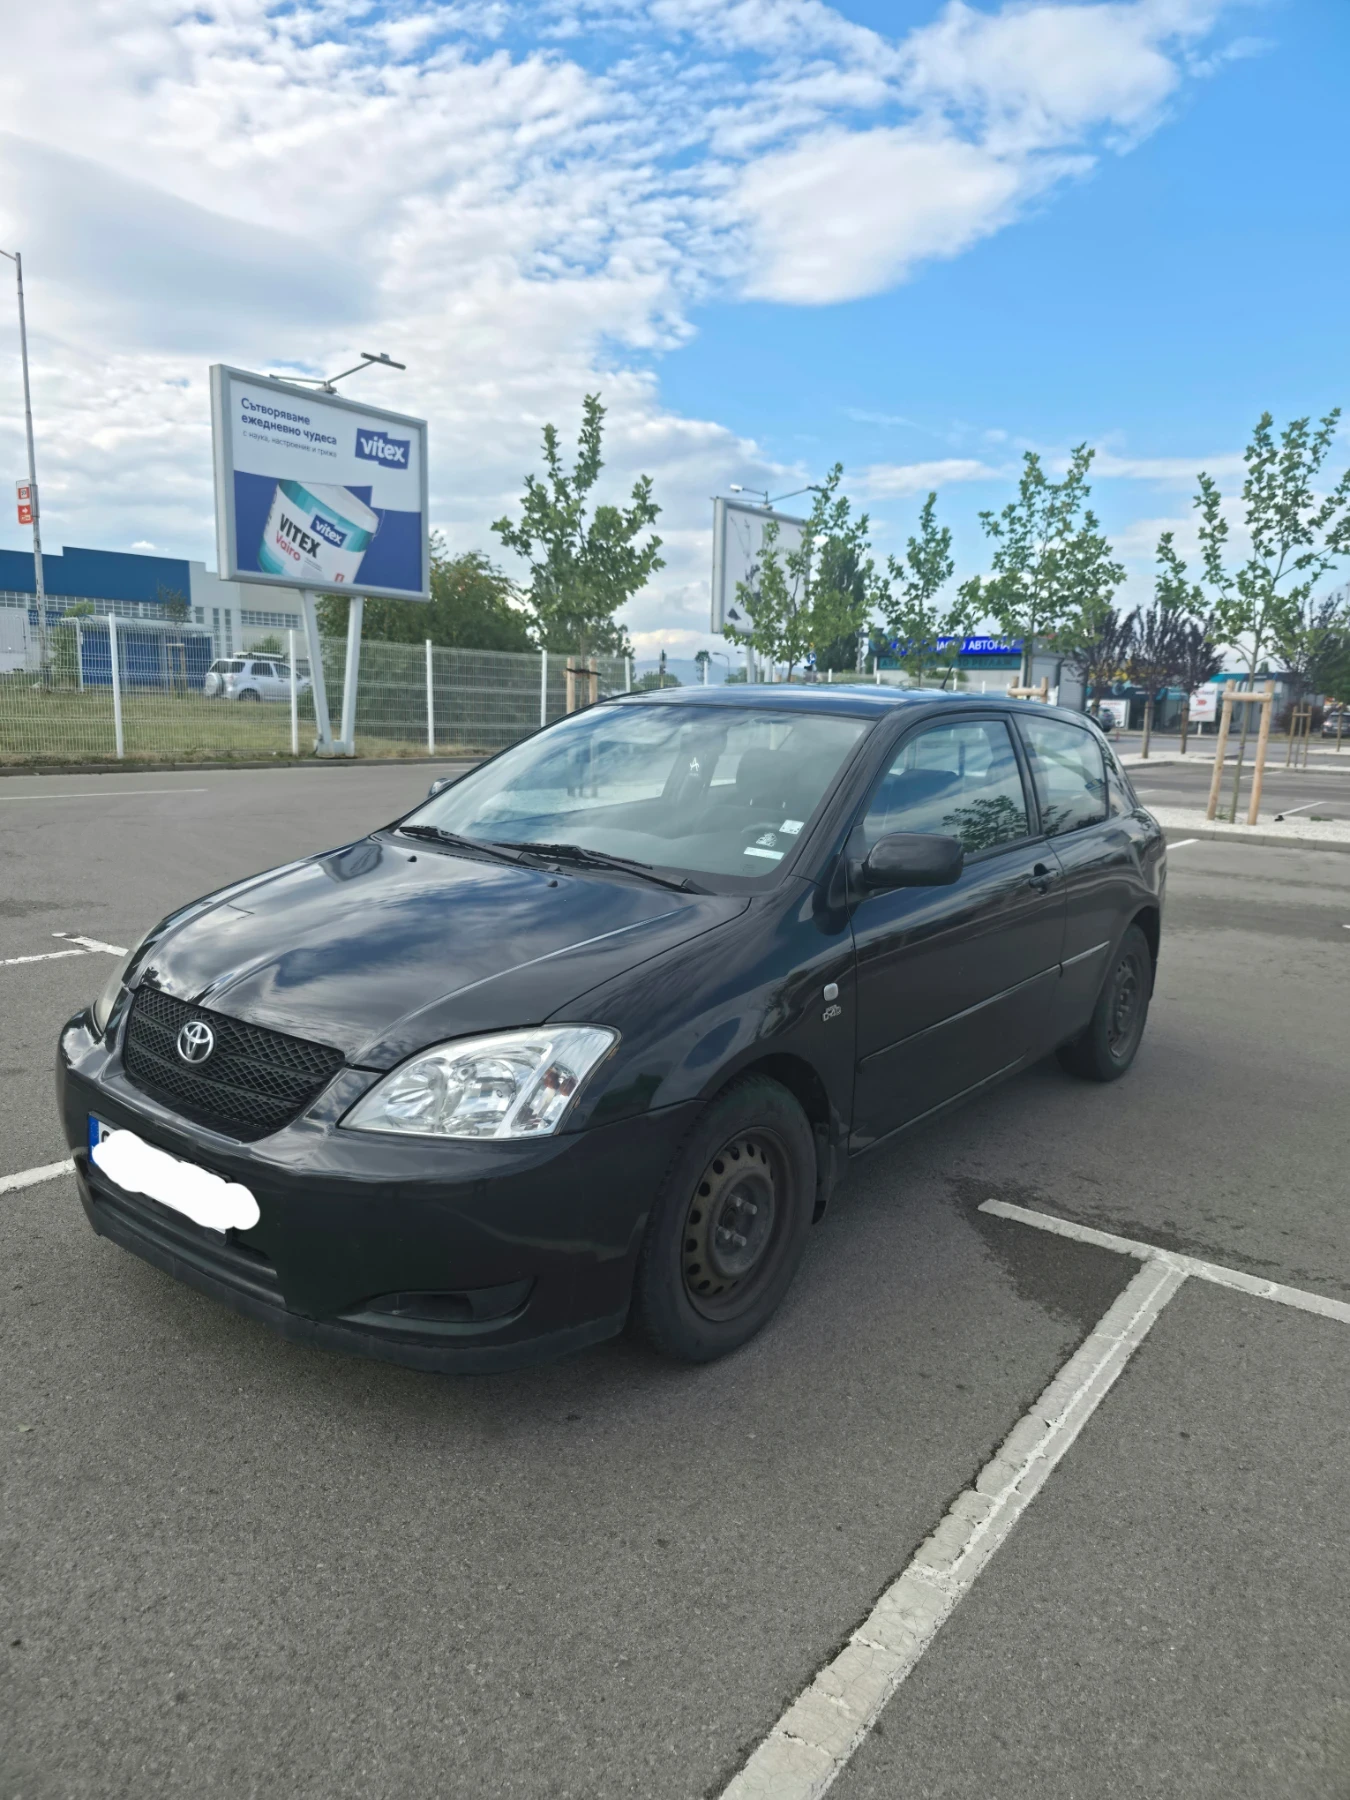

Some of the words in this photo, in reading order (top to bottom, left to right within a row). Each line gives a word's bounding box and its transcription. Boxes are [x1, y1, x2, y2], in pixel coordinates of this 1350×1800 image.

[241, 397, 310, 425] Сътворяваме
[241, 414, 301, 436] ежедневно
[303, 429, 337, 445] чудеса
[360, 436, 405, 463] vitex
[276, 530, 301, 562] Vairo
[280, 512, 321, 559] VITEX
[315, 519, 342, 545] vitex
